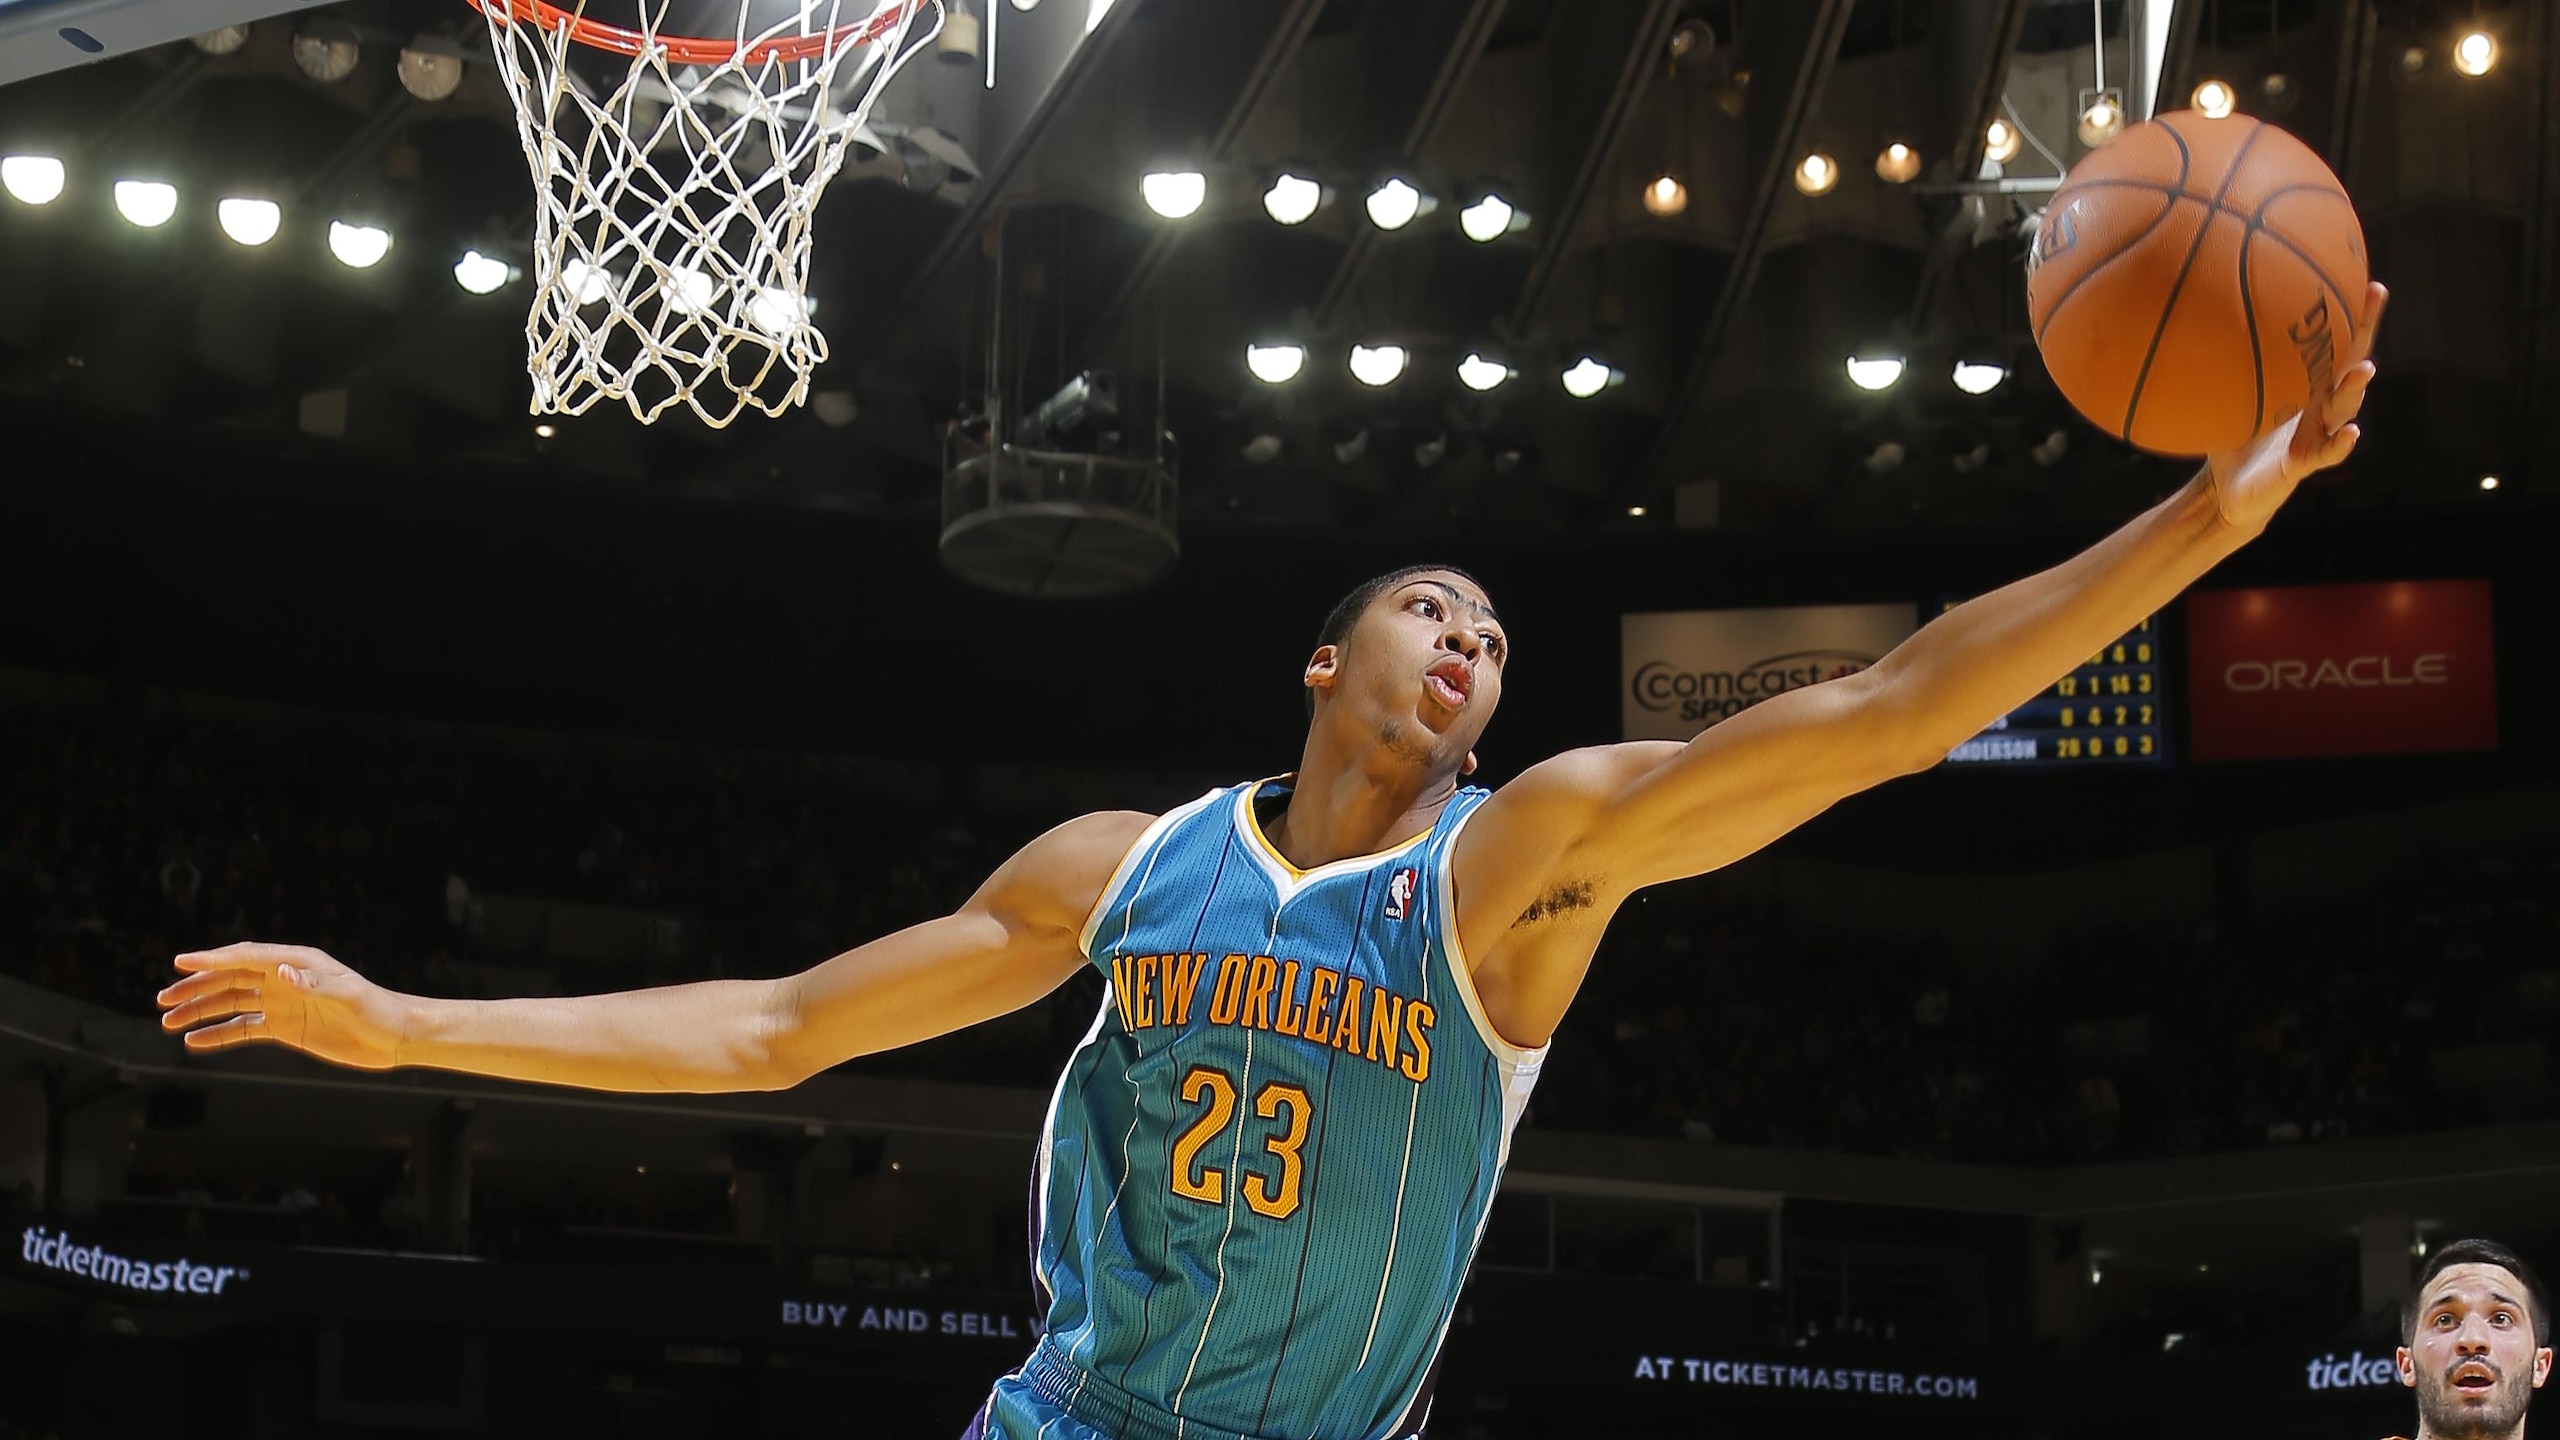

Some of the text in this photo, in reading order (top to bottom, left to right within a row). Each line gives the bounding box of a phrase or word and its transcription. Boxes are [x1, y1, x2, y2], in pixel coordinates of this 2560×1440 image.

[2225, 654, 2449, 691] ORACLE
[1680, 696, 1762, 721] SPO
[1384, 906, 1401, 918] NBA
[1112, 951, 1437, 1084] NEW ORLEANS
[1170, 1065, 1315, 1221] 23
[22, 1226, 236, 1295] ticketmaster
[781, 1301, 848, 1327] BUY
[859, 1307, 929, 1332] AND
[940, 1312, 1018, 1338] SELL
[1634, 1356, 1978, 1398] AT TICKETMASTER.COM
